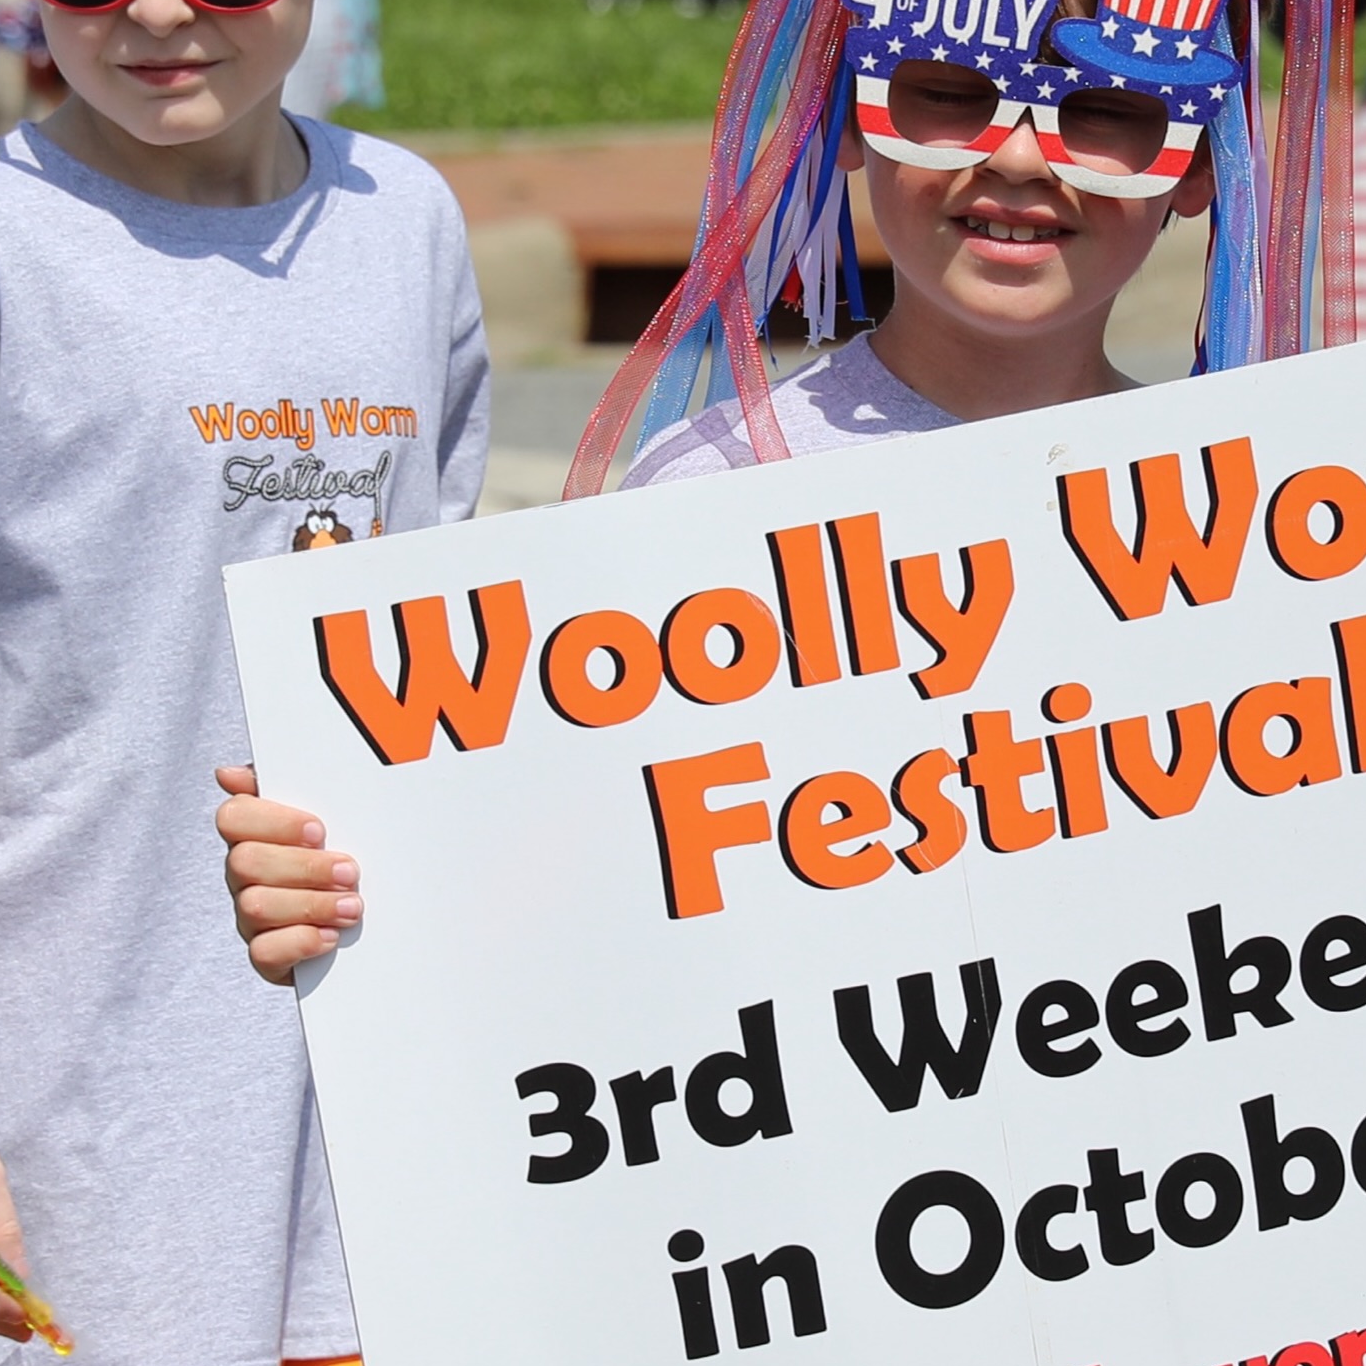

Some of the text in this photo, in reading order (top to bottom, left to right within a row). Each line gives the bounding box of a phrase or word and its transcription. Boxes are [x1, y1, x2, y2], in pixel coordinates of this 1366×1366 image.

[188, 397, 419, 451] Woolly Worm
[222, 449, 392, 513] Festival
[313, 509, 1016, 766] Woolly
[514, 999, 794, 1185] 3rd
[667, 1229, 828, 1361] in
